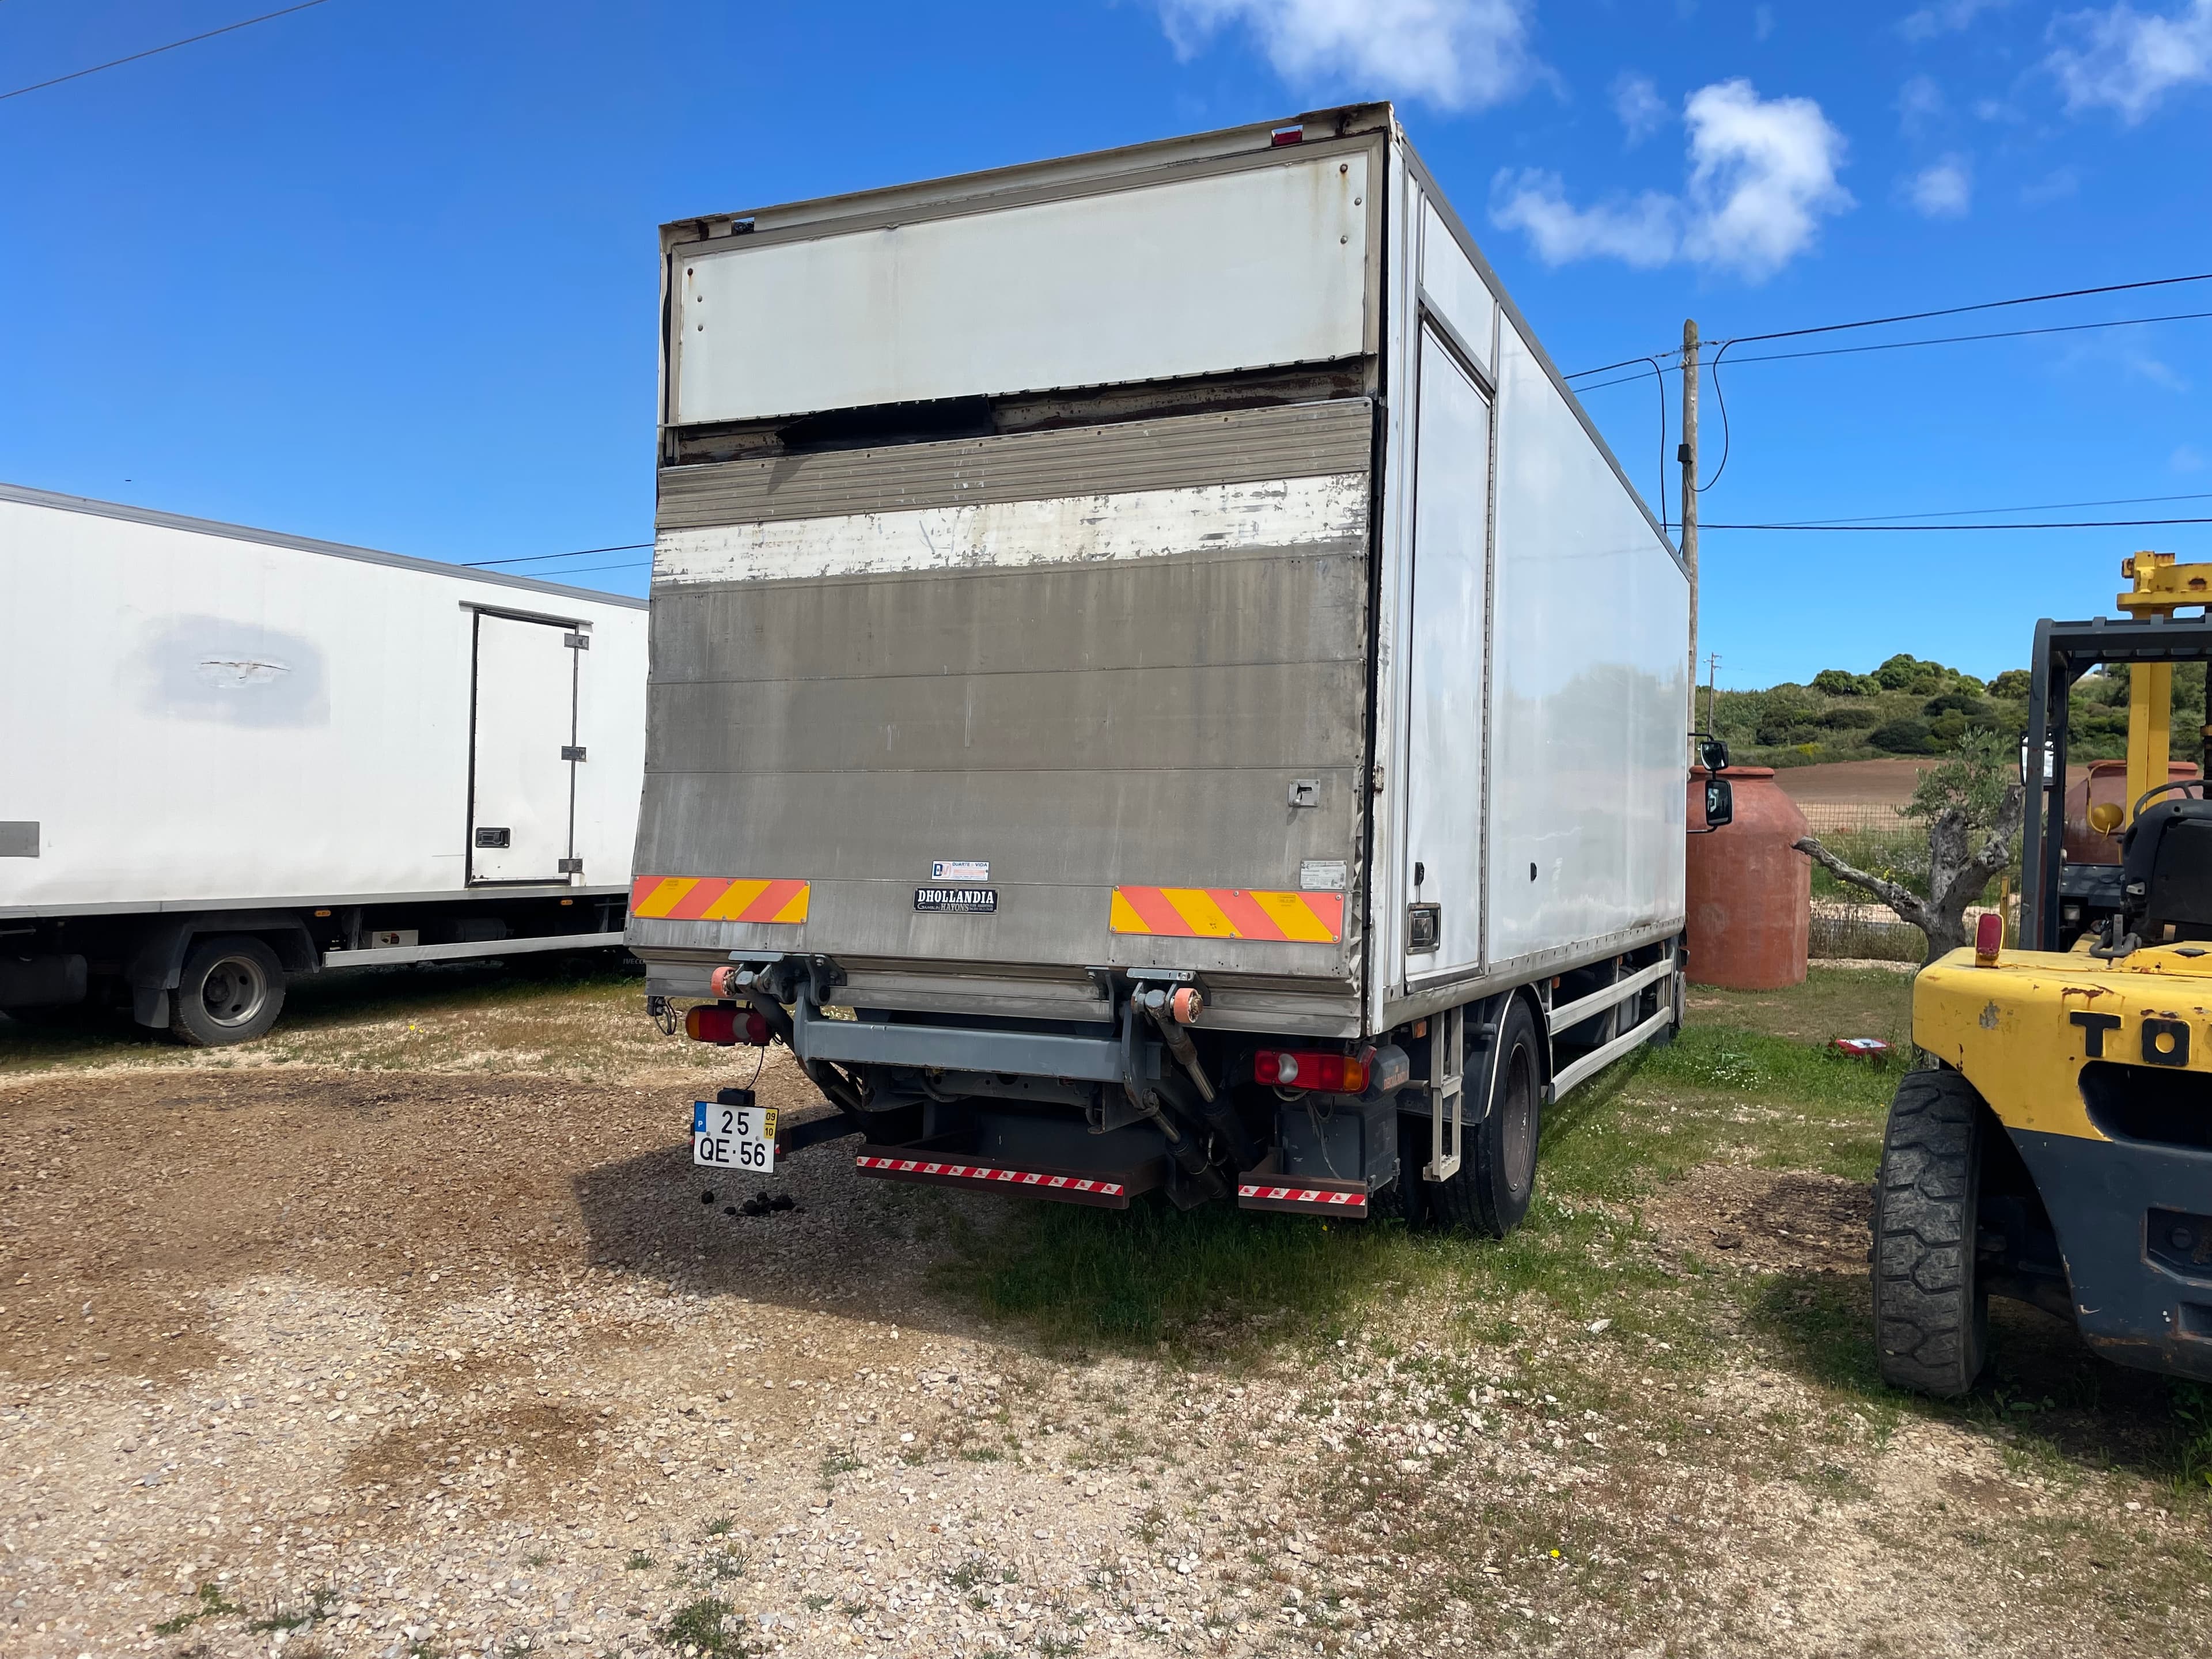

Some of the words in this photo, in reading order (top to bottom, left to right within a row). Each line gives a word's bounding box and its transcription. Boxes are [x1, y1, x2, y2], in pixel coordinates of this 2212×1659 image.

[918, 890, 994, 903] DHOLLANDIA
[941, 903, 969, 911] HAYONS
[766, 1112, 775, 1121] 09
[721, 1110, 749, 1135] 25
[765, 1127, 773, 1137] 10
